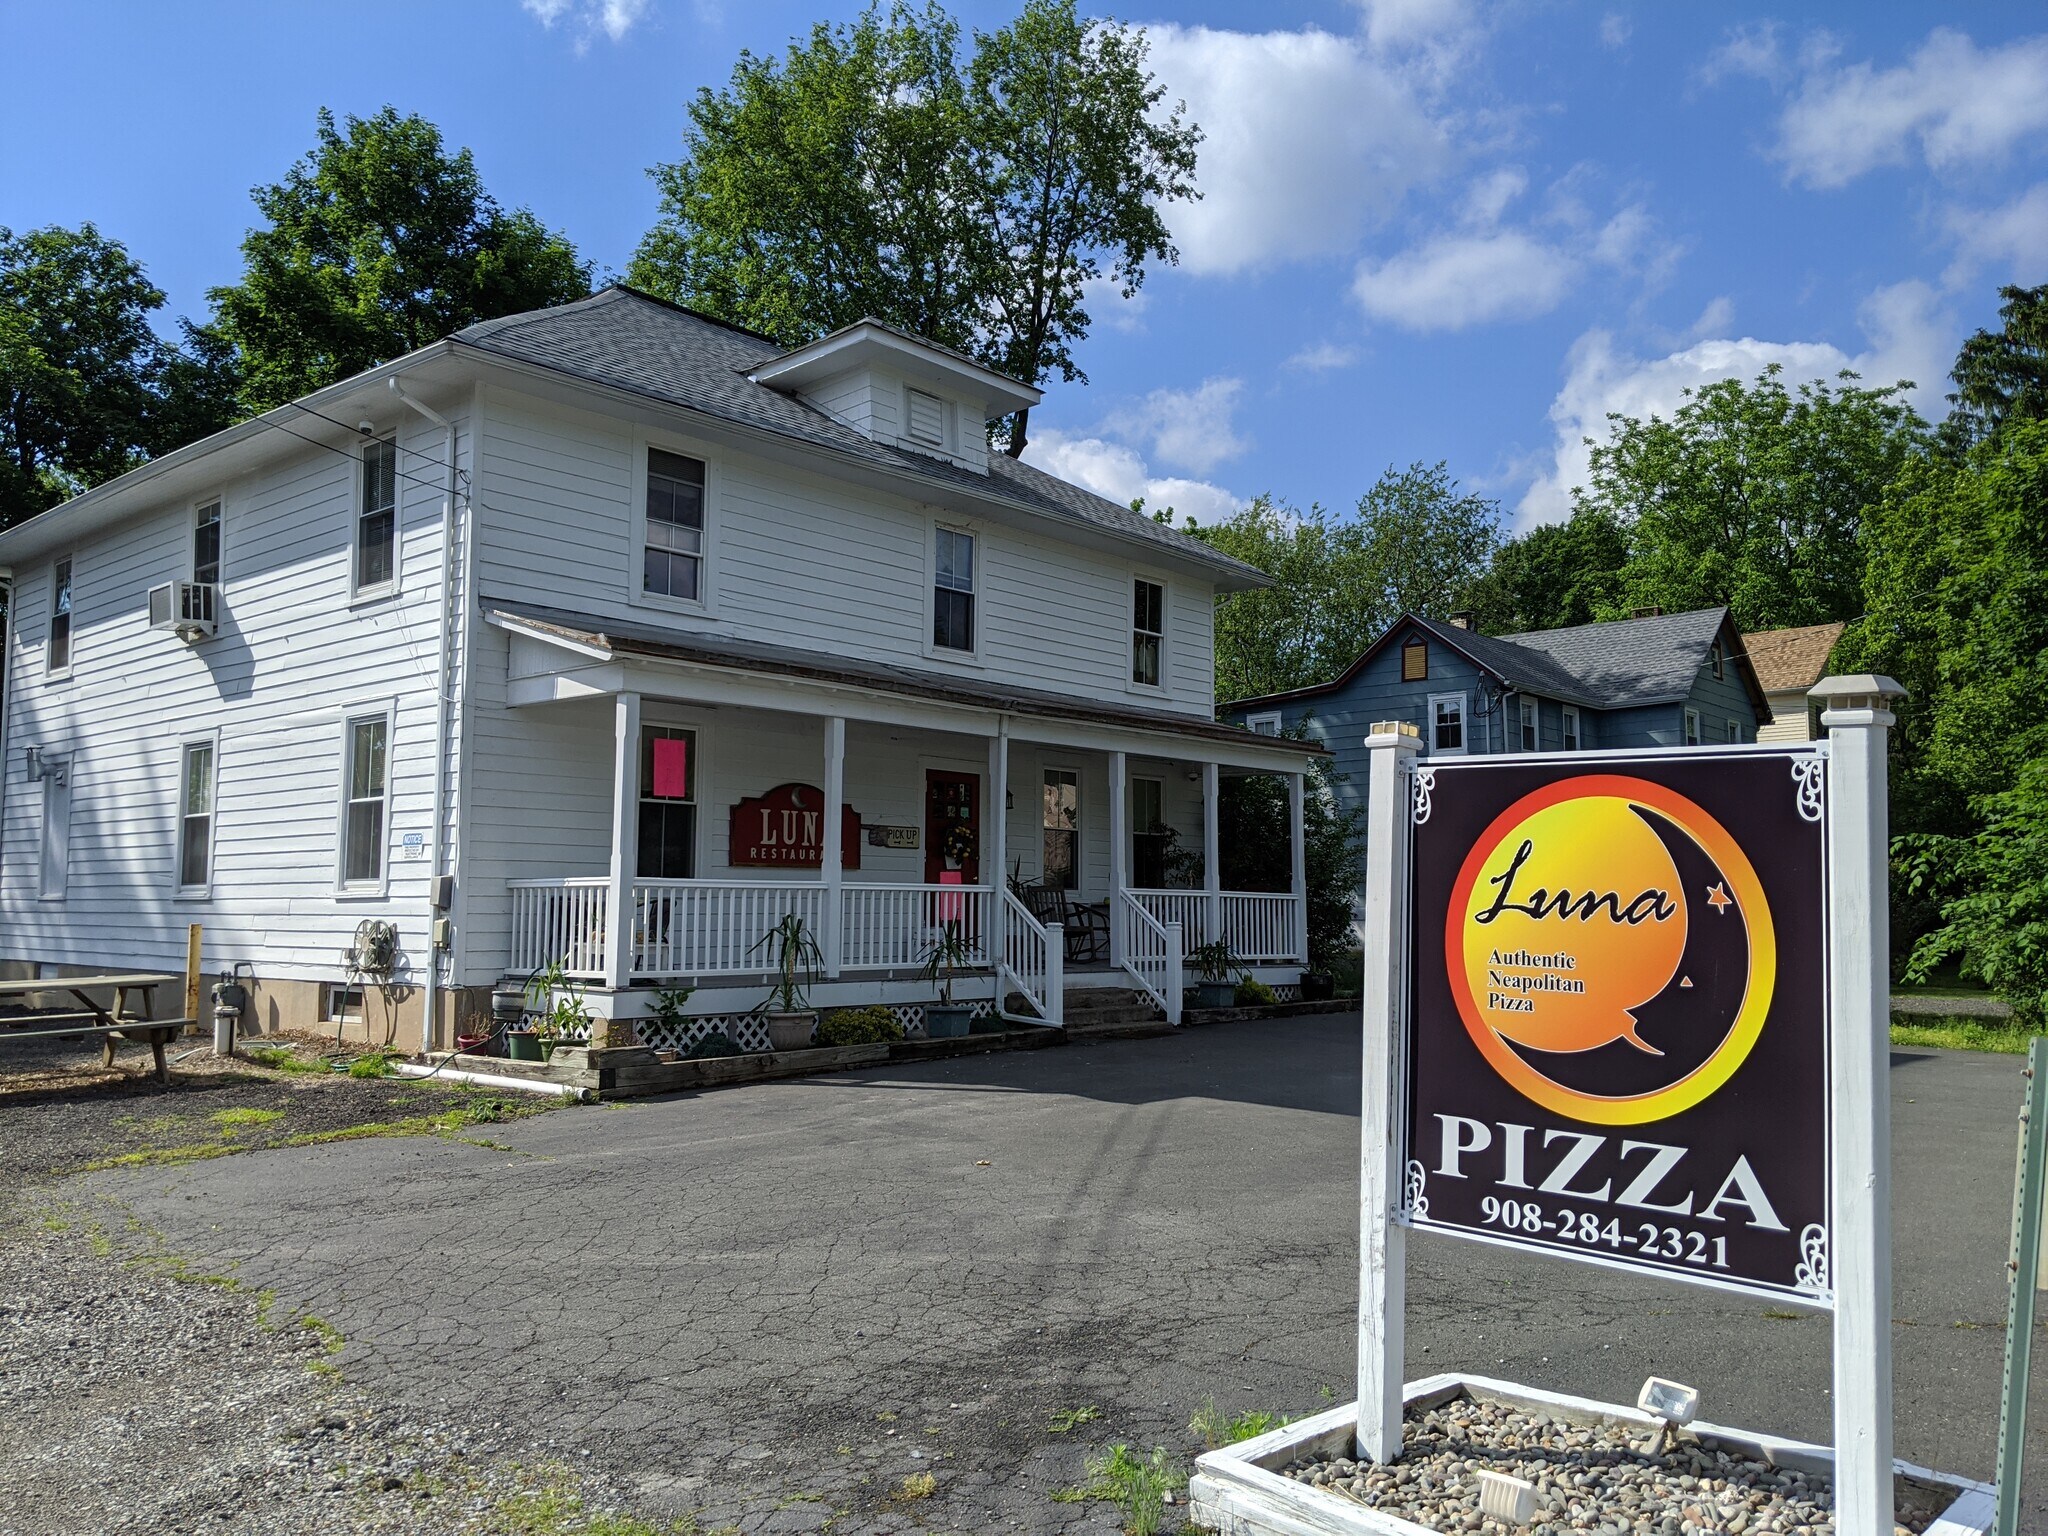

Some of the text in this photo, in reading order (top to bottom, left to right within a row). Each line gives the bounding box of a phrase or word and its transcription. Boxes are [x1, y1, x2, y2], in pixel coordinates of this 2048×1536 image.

[760, 809, 824, 846] LUN
[887, 829, 917, 839] PICK UP
[404, 835, 422, 844] NOTICE
[1474, 839, 1676, 925] Luna
[1488, 949, 1576, 969] Authentic
[1488, 970, 1585, 993] Neapolitan
[1488, 992, 1534, 1012] Pizza
[1432, 1112, 1791, 1232] PIZZA
[1480, 1195, 1731, 1269] 908-284-2321
